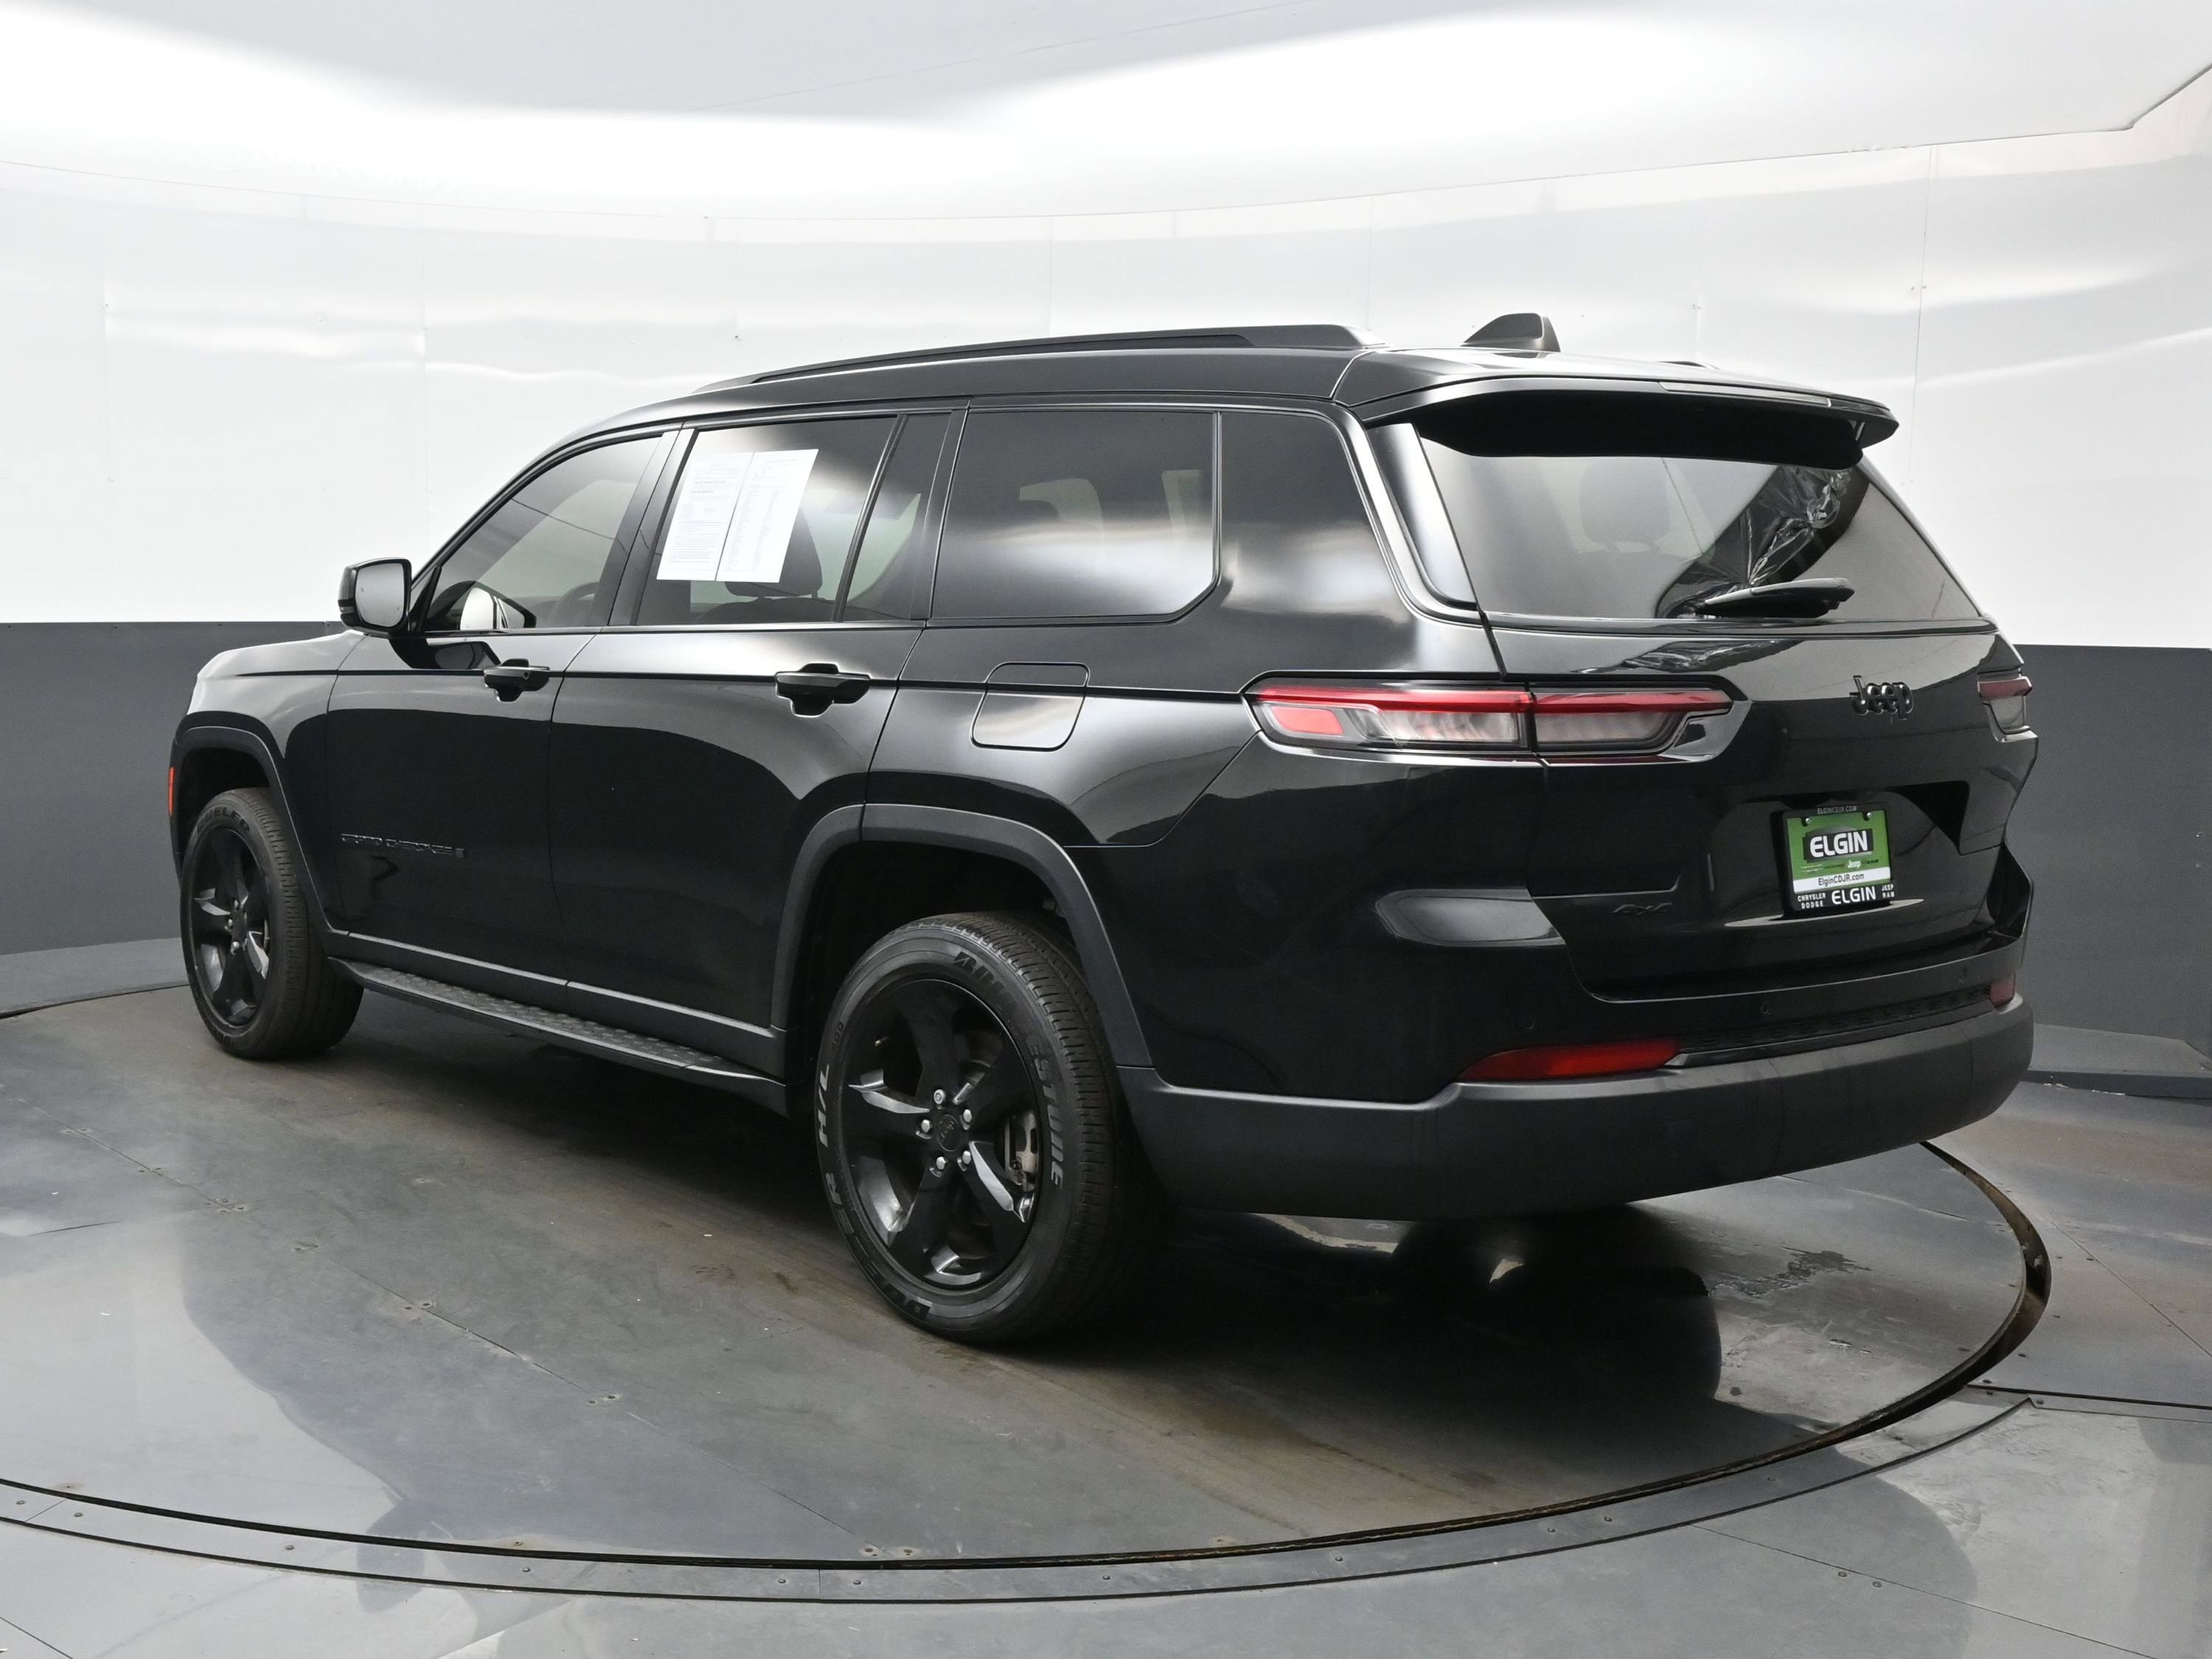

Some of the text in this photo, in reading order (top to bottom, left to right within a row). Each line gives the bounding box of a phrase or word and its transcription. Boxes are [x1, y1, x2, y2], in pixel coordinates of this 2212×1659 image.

[1848, 675, 1914, 720] Jeep
[1809, 830, 1868, 858] ELGIN
[1847, 860, 1862, 869] Jeep
[1818, 872, 1865, 887] ElginCDJR.com
[1797, 892, 1826, 902] CHRYSLER
[1831, 886, 1877, 905] ELGIN
[1801, 901, 1824, 909] DODGE
